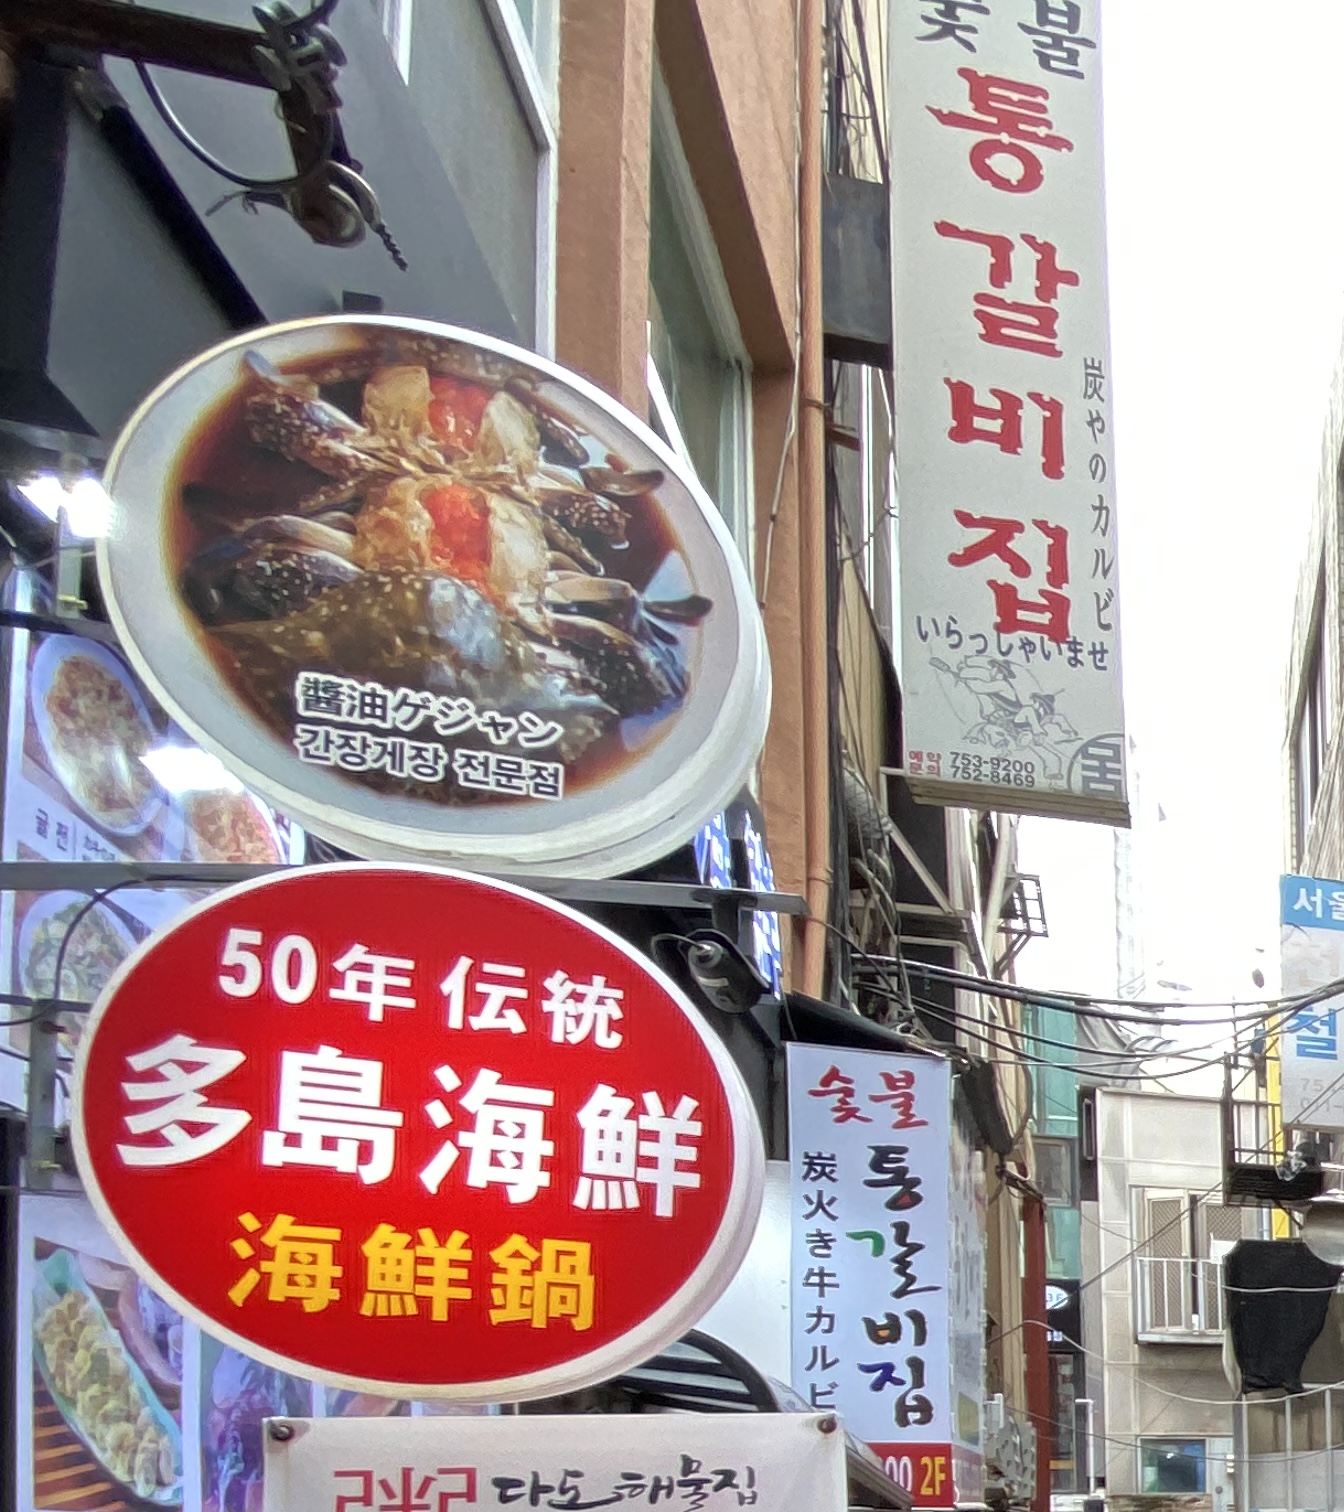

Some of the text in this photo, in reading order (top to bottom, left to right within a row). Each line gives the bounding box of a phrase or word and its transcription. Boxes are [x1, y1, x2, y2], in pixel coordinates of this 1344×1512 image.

[925, 66, 1074, 644] 통갈비집
[1083, 357, 1115, 632] 炭やのカルビ
[916, 615, 1109, 672] いらっしゃいませ
[297, 726, 564, 799] 간장게장 전문점
[949, 752, 1035, 774] 753-9200
[951, 764, 1036, 788] 752-8469
[116, 1031, 704, 1218] 多島海鮮
[808, 1064, 929, 1130] 숯불
[227, 1212, 597, 1332] 海鮮鍋
[801, 1150, 840, 1411] 炭火き牛カルビ
[845, 1145, 943, 1428] 통갈비집
[920, 1456, 946, 1496] 2F
